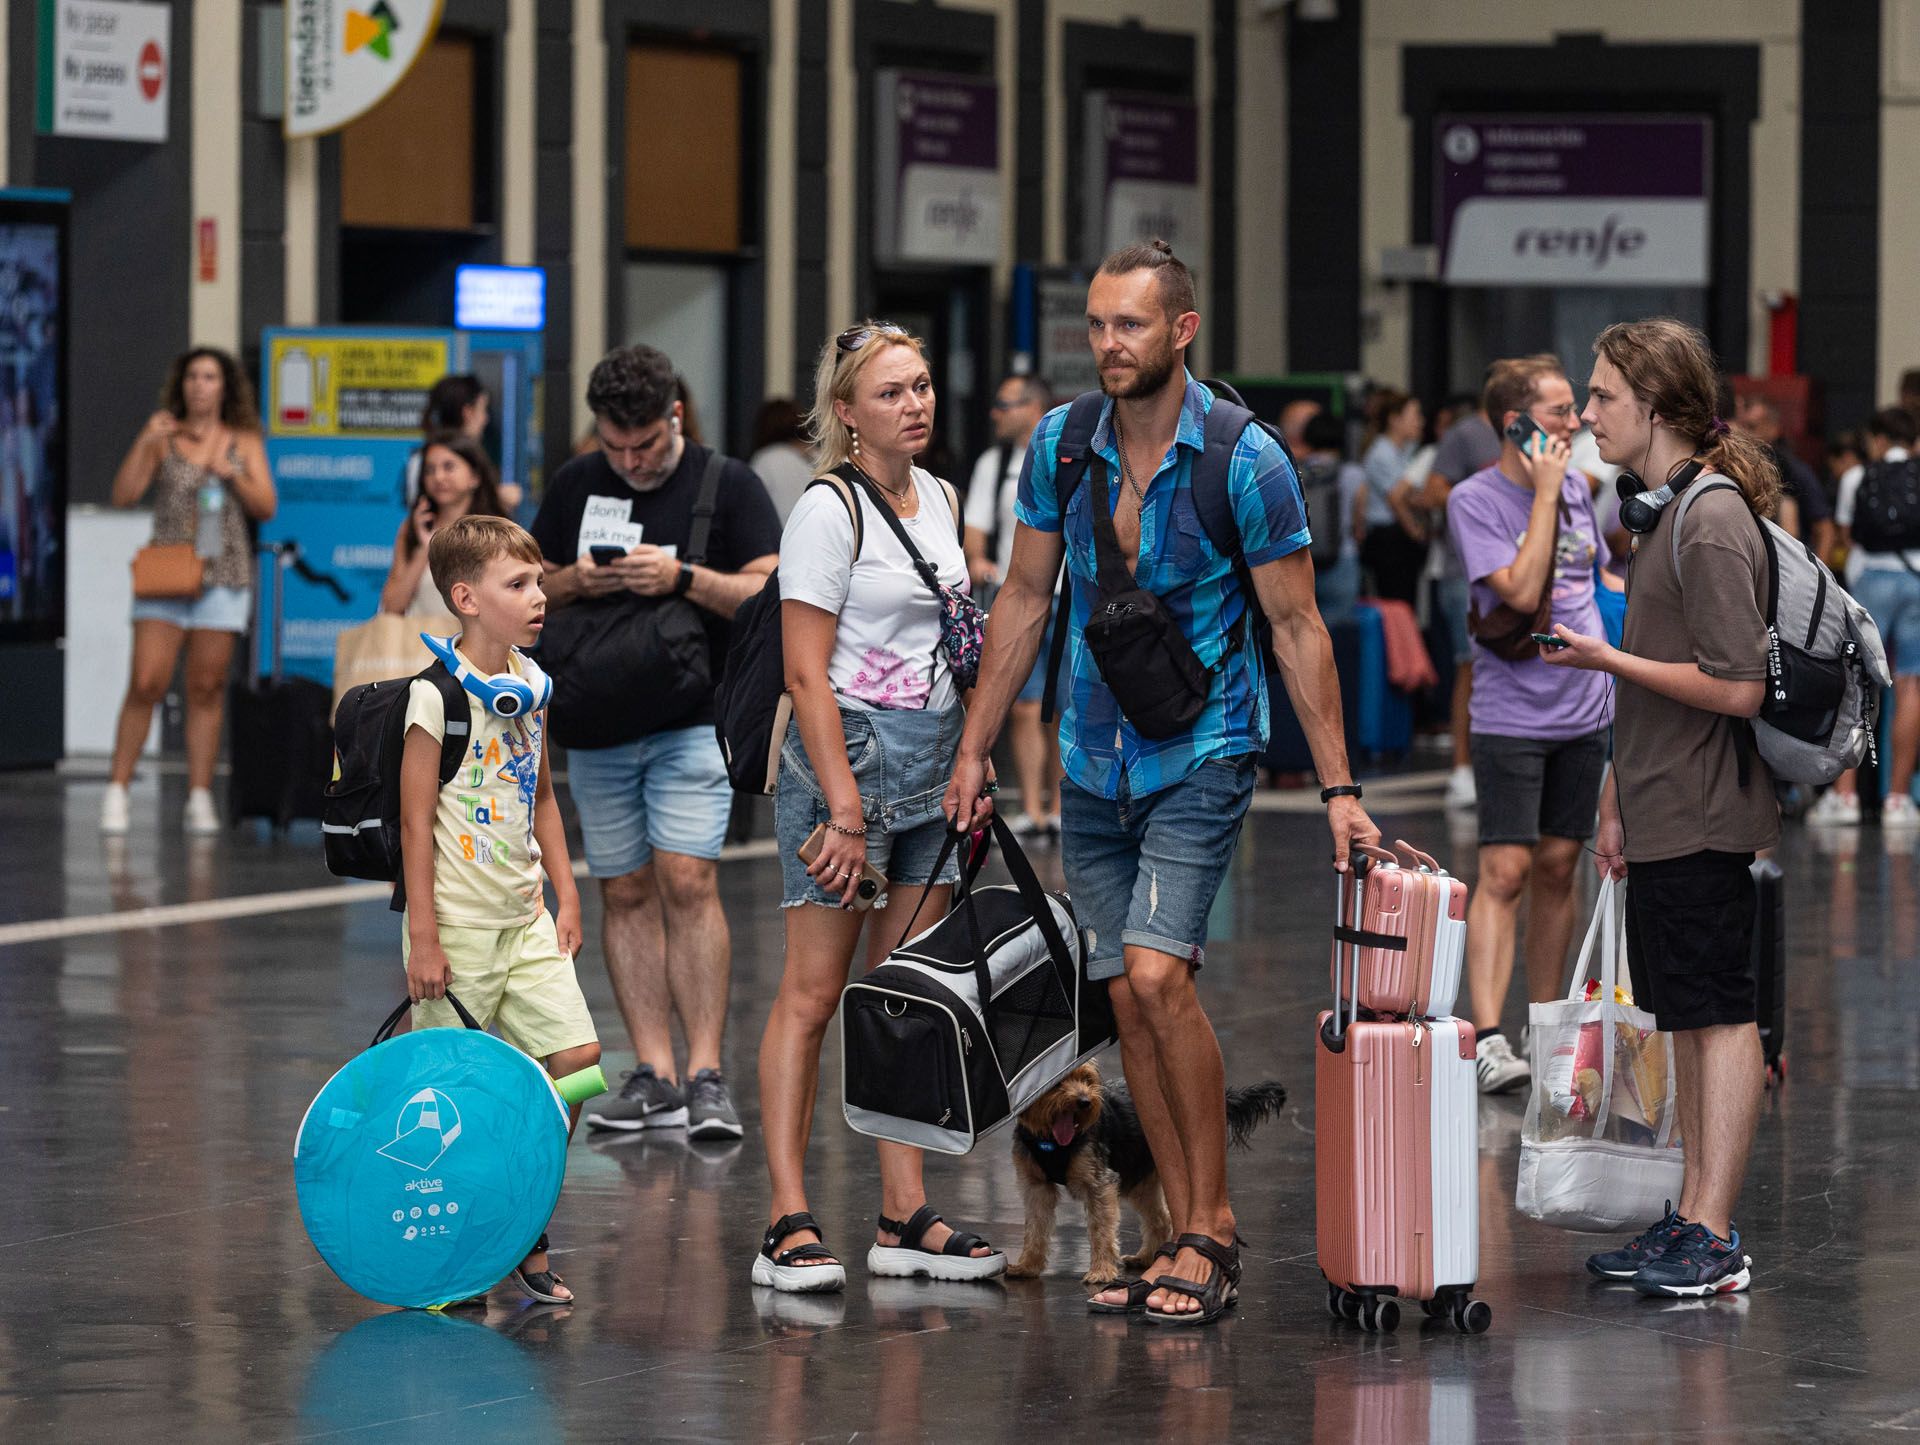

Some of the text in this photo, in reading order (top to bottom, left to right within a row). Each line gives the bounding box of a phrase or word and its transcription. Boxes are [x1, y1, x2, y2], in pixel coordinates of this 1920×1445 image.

[1514, 212, 1647, 269] renfe
[588, 503, 627, 519] don't
[583, 529, 636, 543] ask me
[1771, 632, 1782, 675] Chinese
[459, 833, 511, 866] BRO
[405, 1177, 443, 1192] aktive
